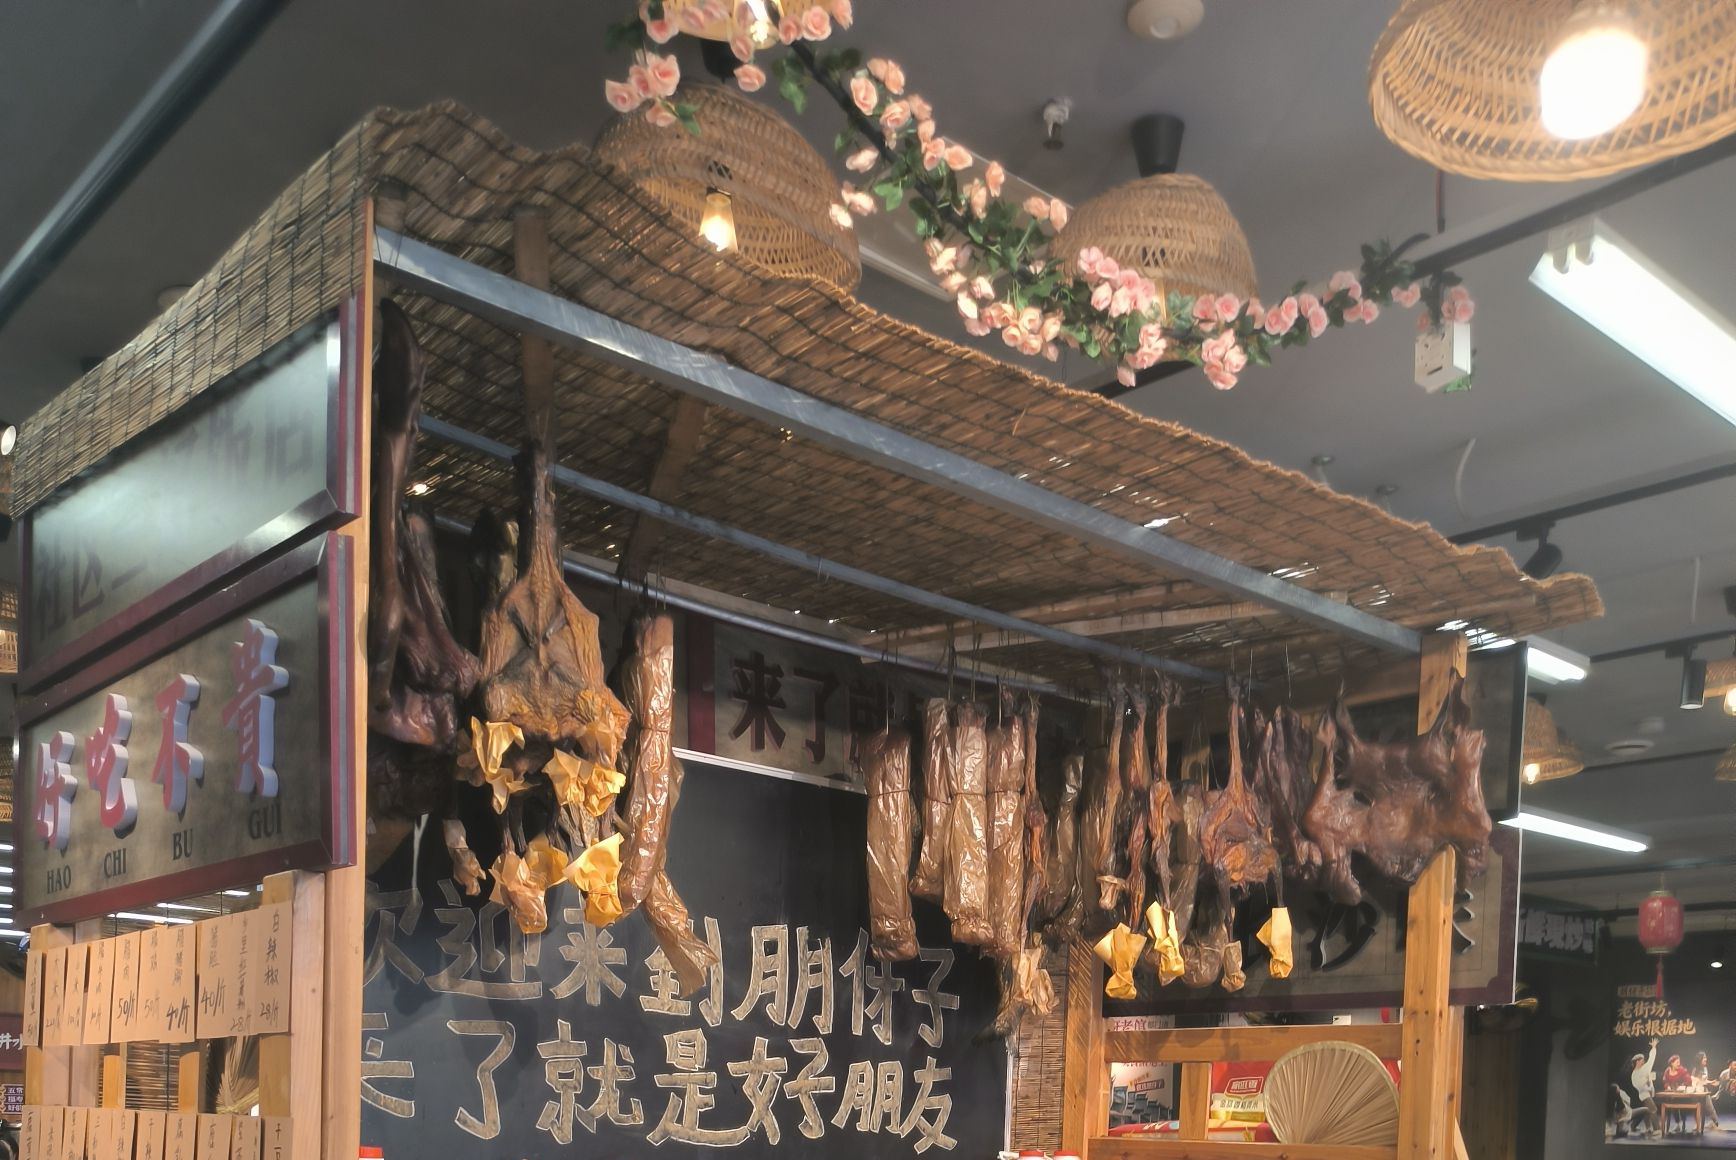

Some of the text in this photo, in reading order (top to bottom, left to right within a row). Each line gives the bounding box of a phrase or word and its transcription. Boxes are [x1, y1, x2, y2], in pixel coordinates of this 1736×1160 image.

[729, 651, 890, 765] 来了
[46, 803, 283, 893] HAO CHI BU GUI
[1613, 1018, 1697, 1038] 娱乐根据地
